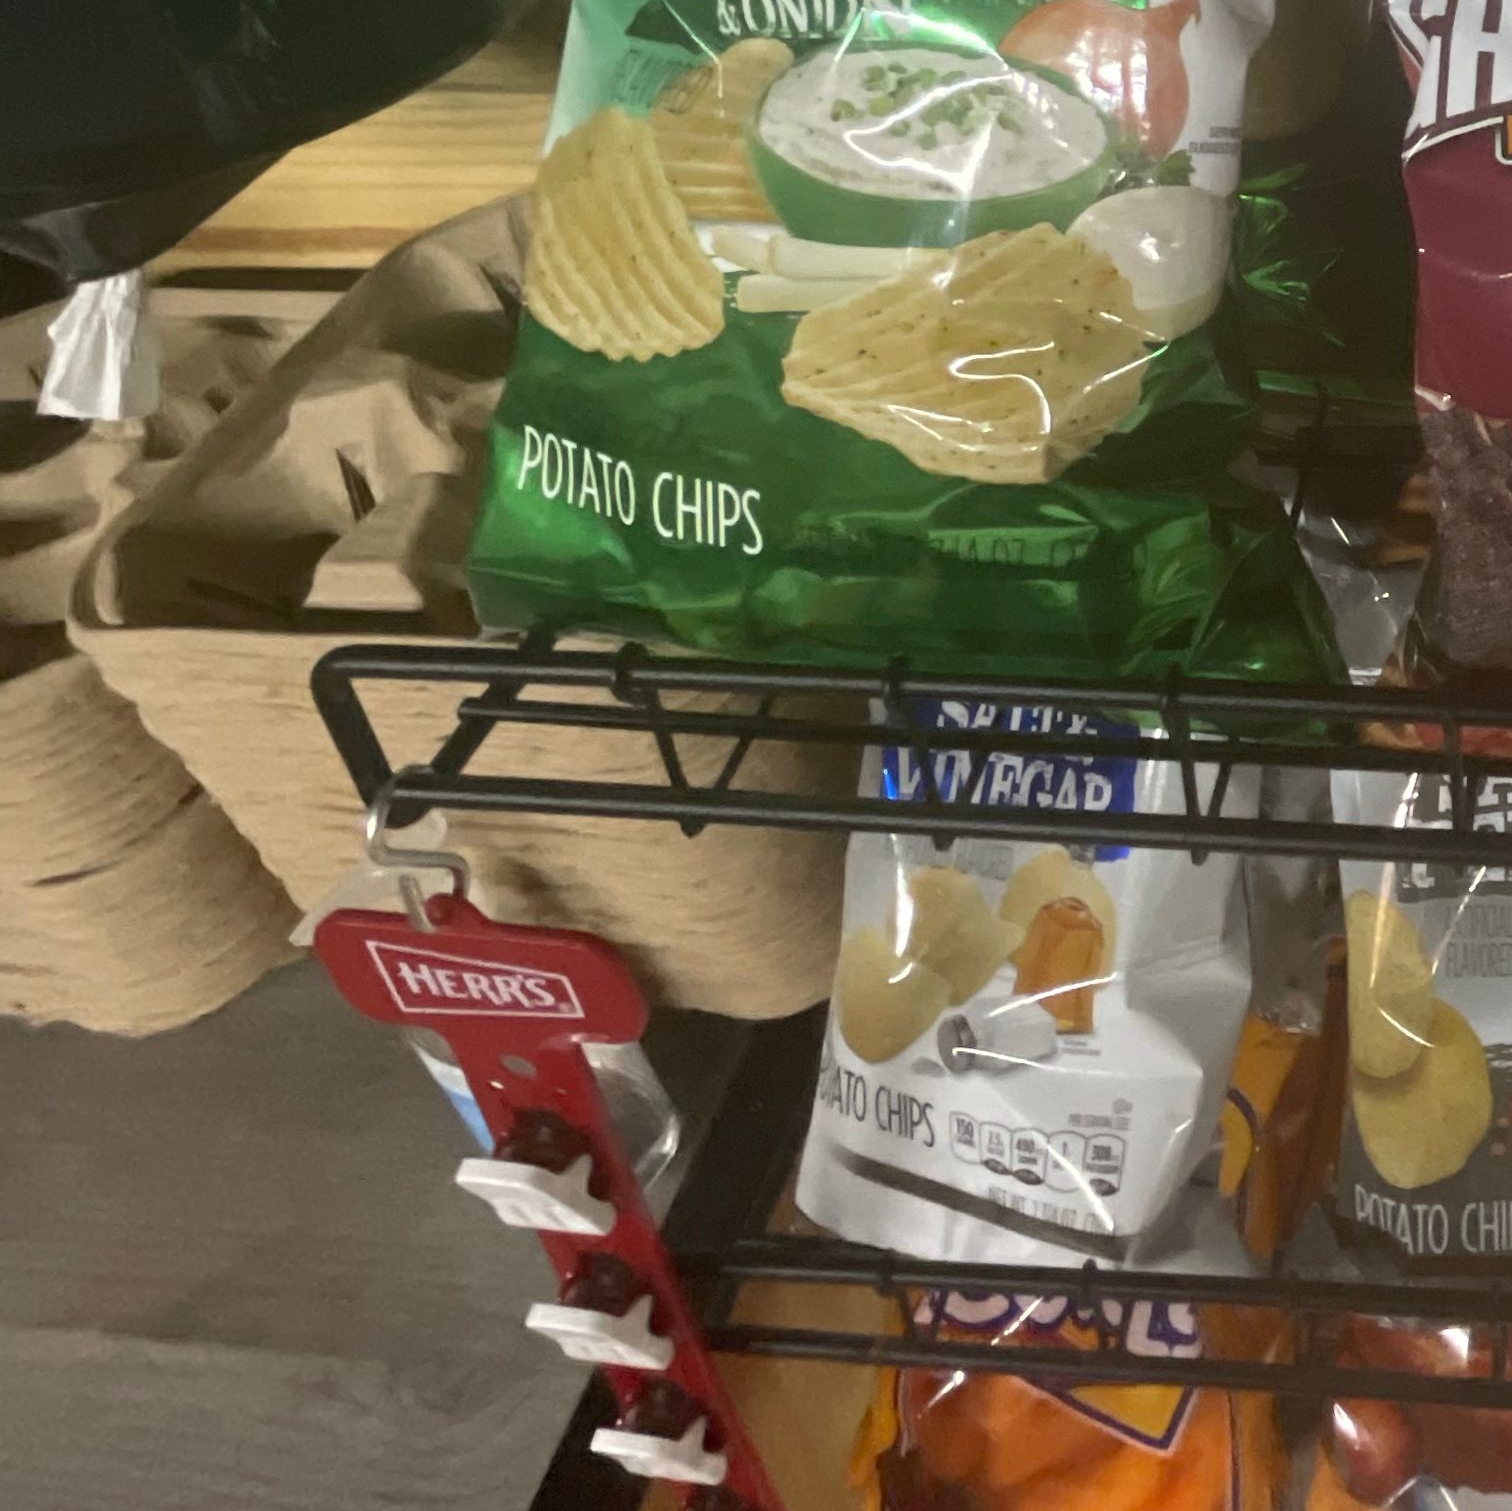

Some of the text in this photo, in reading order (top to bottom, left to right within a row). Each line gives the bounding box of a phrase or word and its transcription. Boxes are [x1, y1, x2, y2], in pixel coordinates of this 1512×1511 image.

[517, 424, 636, 527] POTATO
[652, 471, 763, 556] CHIPS
[398, 961, 556, 1014] HERR'S
[875, 1085, 936, 1148] CHIPS
